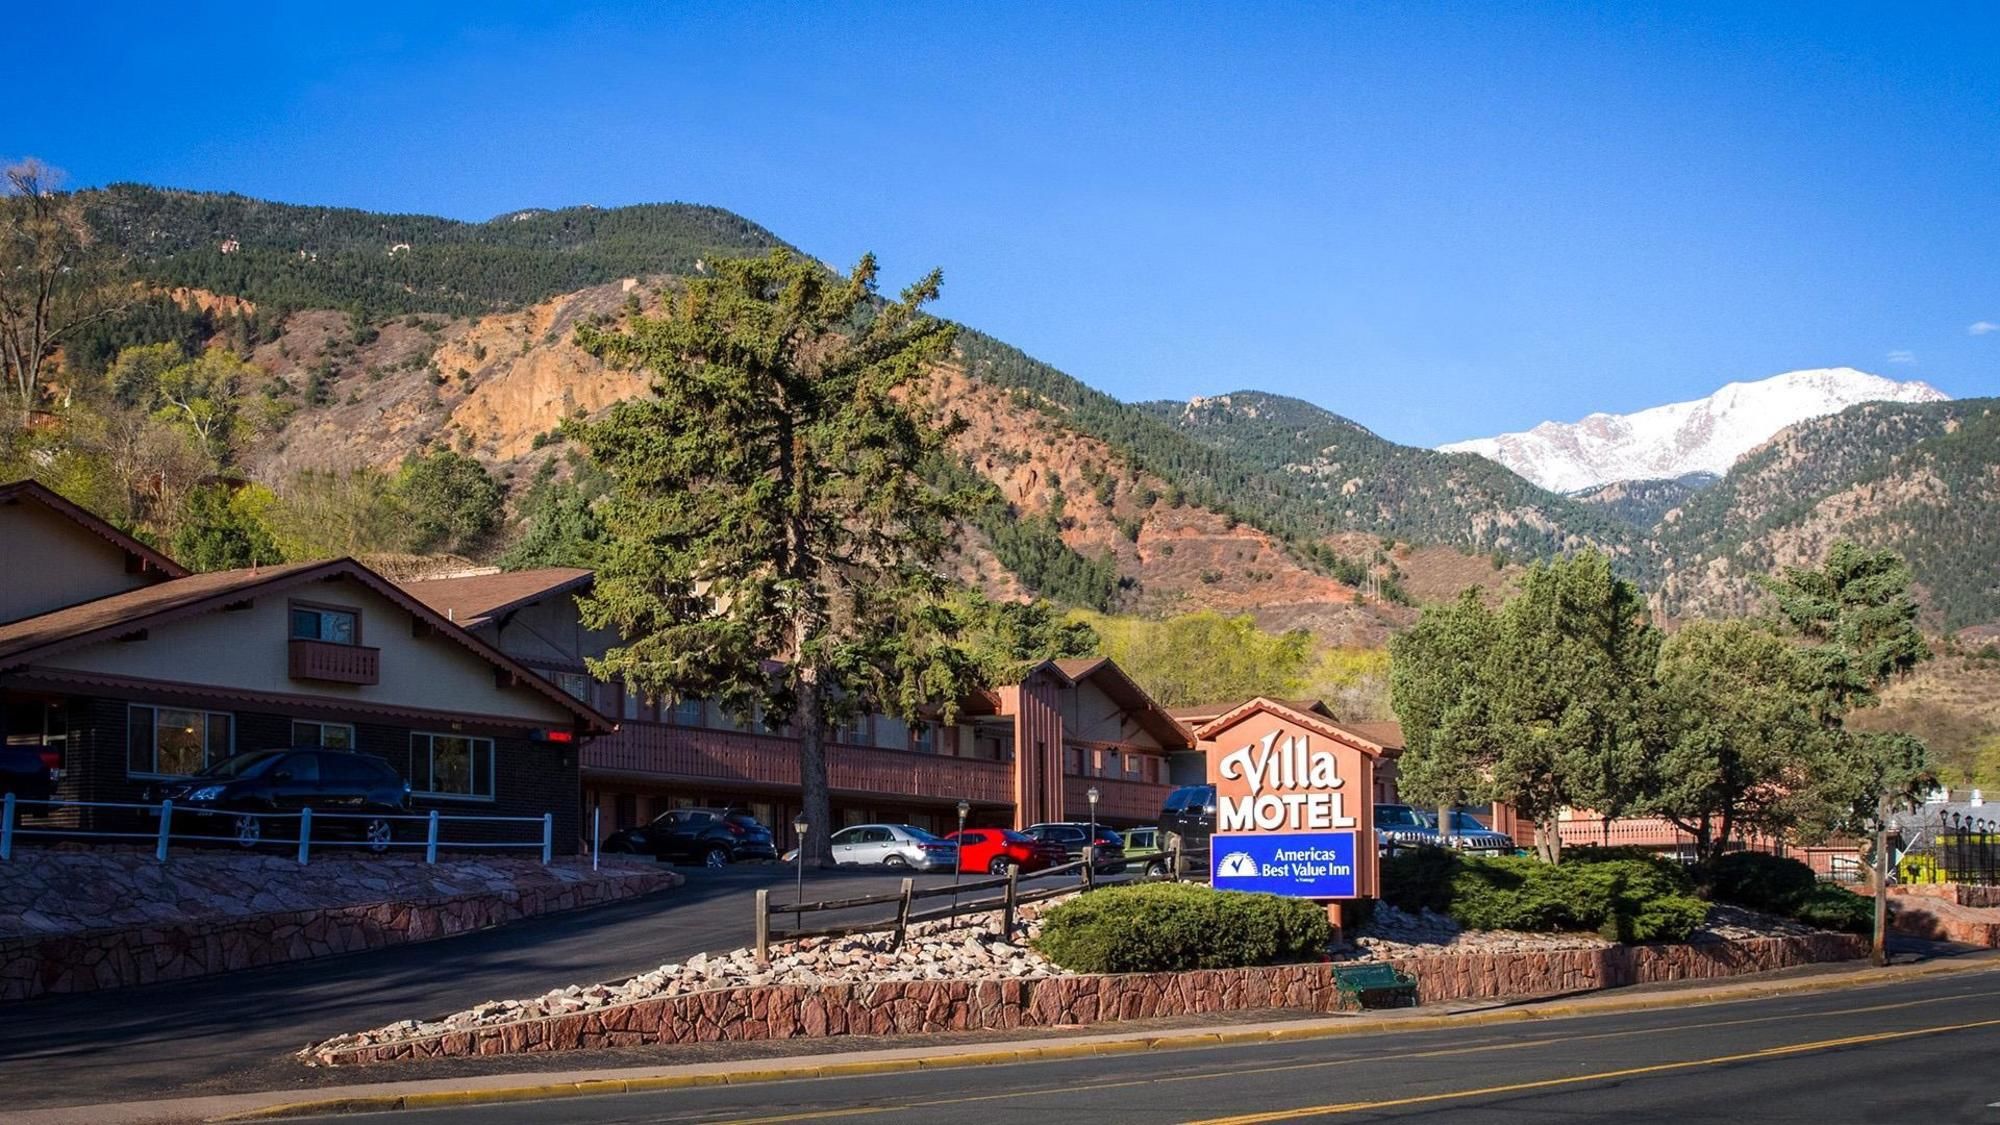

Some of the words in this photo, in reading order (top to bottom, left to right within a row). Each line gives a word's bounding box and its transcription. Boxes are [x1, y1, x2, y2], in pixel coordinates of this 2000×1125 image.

[1219, 728, 1344, 796] Villa
[1219, 792, 1356, 831] MOTEL
[1274, 847, 1336, 862] Americas
[1262, 863, 1289, 877] Best
[1292, 863, 1326, 877] Value
[1329, 863, 1350, 876] Inn
